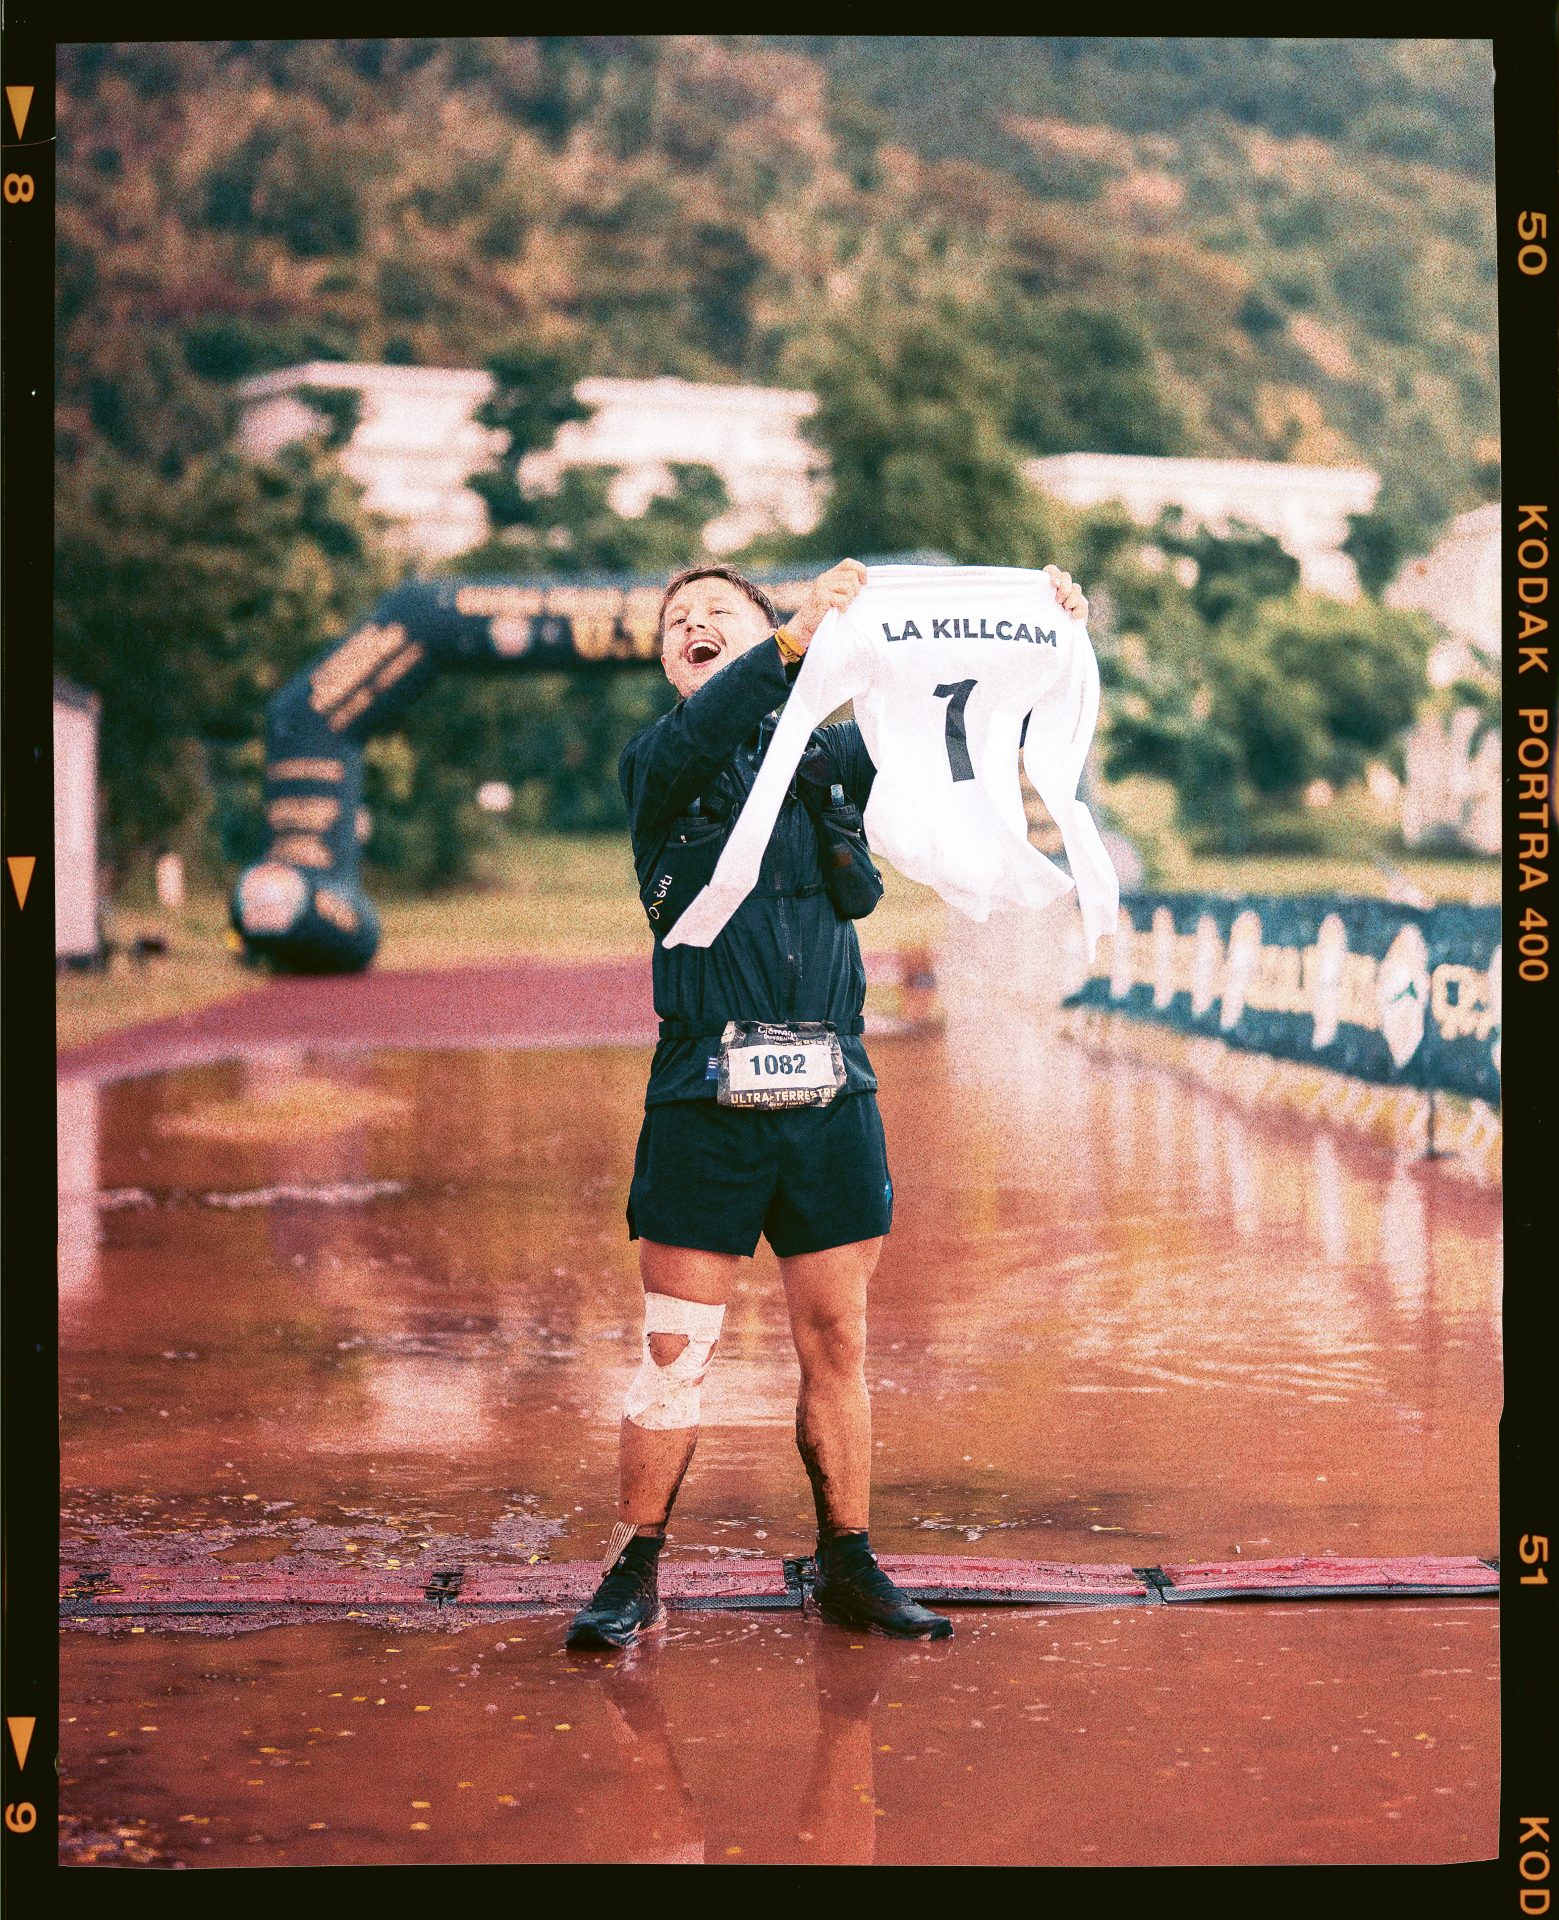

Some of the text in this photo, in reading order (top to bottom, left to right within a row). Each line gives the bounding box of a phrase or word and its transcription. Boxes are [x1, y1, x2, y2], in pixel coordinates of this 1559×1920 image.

[881, 618, 1058, 648] LA KILLCAM
[932, 678, 979, 783] 1
[749, 1053, 807, 1076] 1082
[730, 1087, 837, 1104] ULTRA-TERRESTRE
